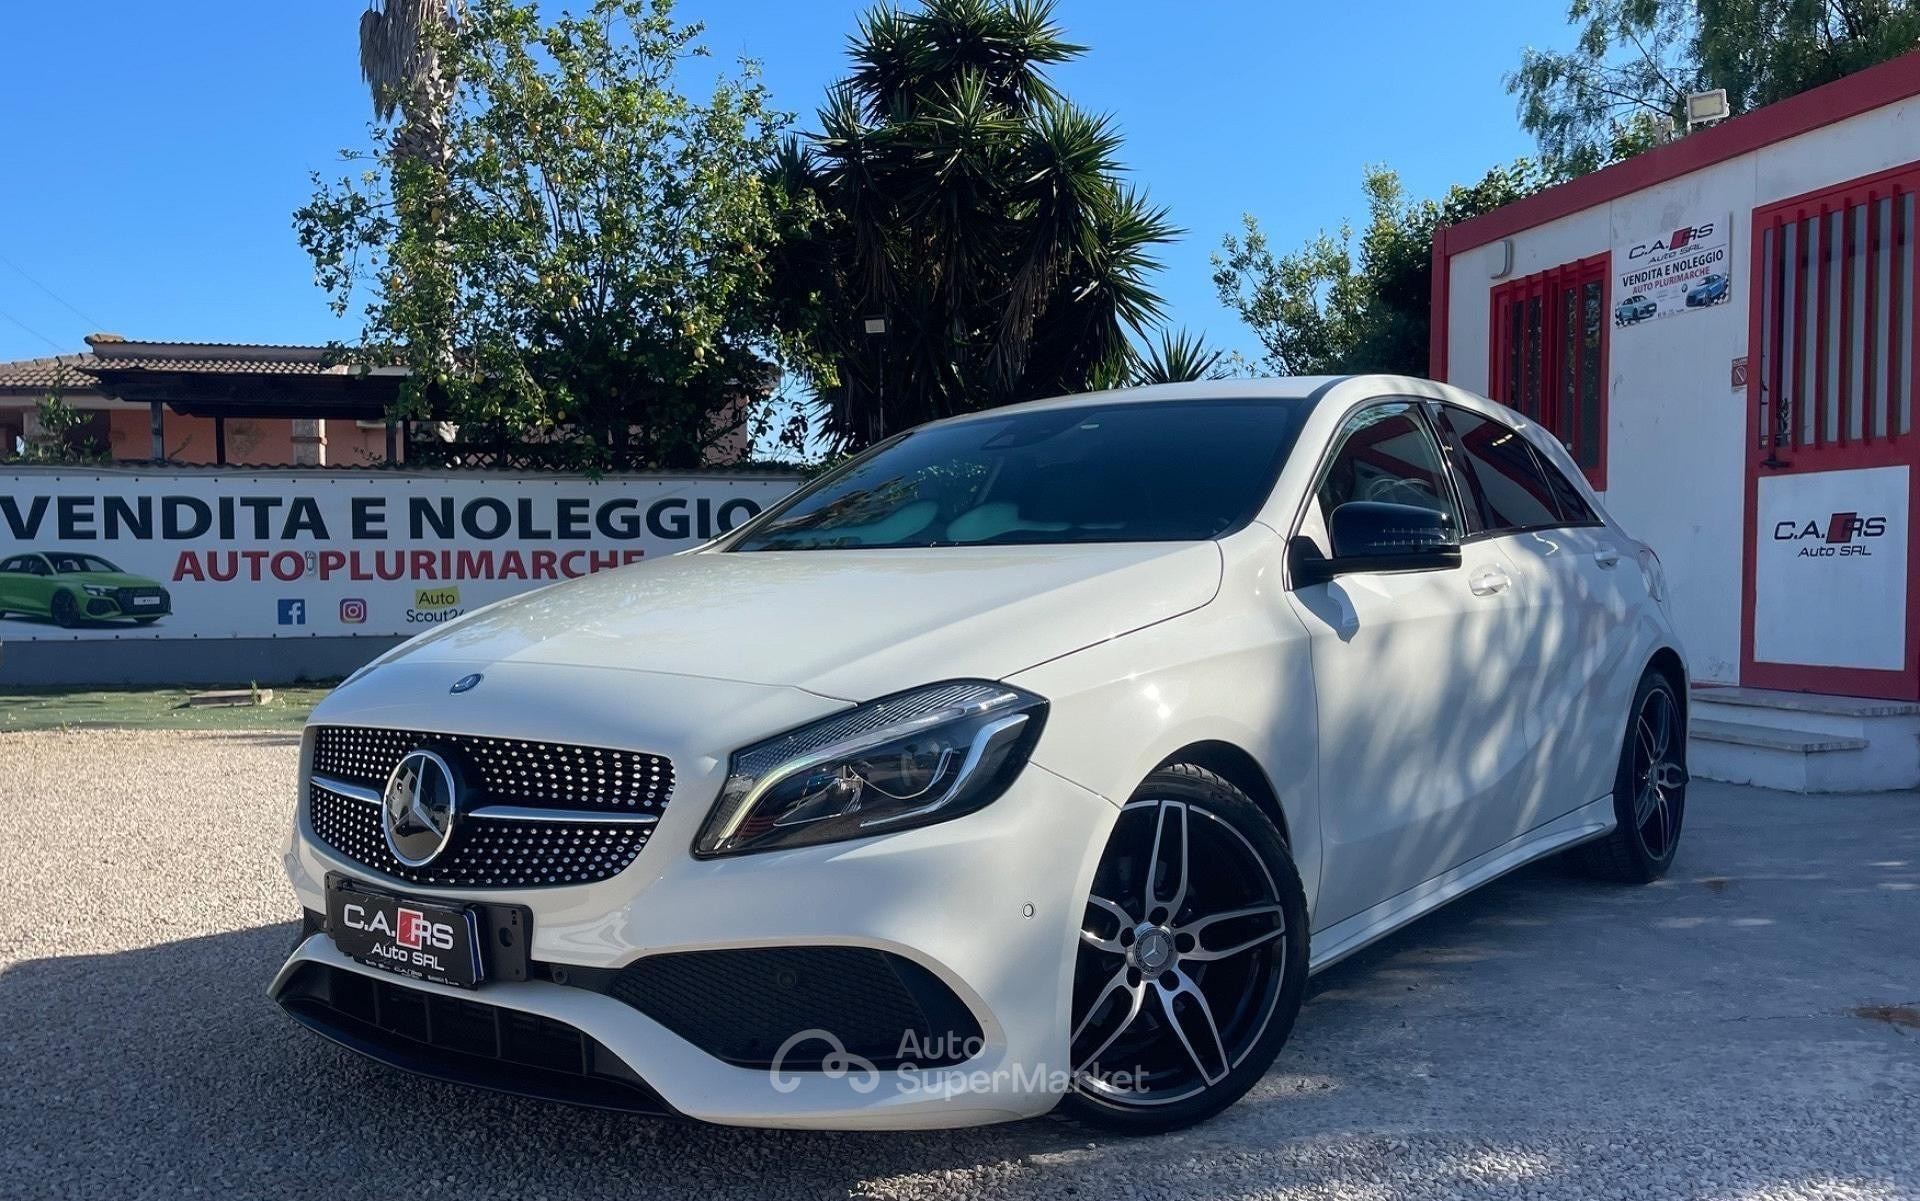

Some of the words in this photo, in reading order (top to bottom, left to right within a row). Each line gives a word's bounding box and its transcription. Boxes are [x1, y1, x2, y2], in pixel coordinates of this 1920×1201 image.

[1648, 252, 1677, 264] Auto
[1680, 243, 1704, 257] SRL
[1622, 269, 1663, 287] VENDITA
[1665, 264, 1670, 275] E
[1672, 250, 1724, 273] NOLEGGIO
[1632, 283, 1653, 295] AUTO
[1654, 266, 1711, 289] PLURIMARCHE
[0, 495, 330, 541] VENDITA
[351, 497, 388, 541] E
[409, 497, 763, 541] NOLEGGIO
[1798, 547, 1835, 557] Auto
[1839, 545, 1872, 556] SRL
[172, 550, 305, 582] AUTO
[418, 591, 456, 605] Auto
[406, 608, 465, 624] Scout2
[371, 942, 408, 962] Auto
[412, 951, 445, 972] SRL
